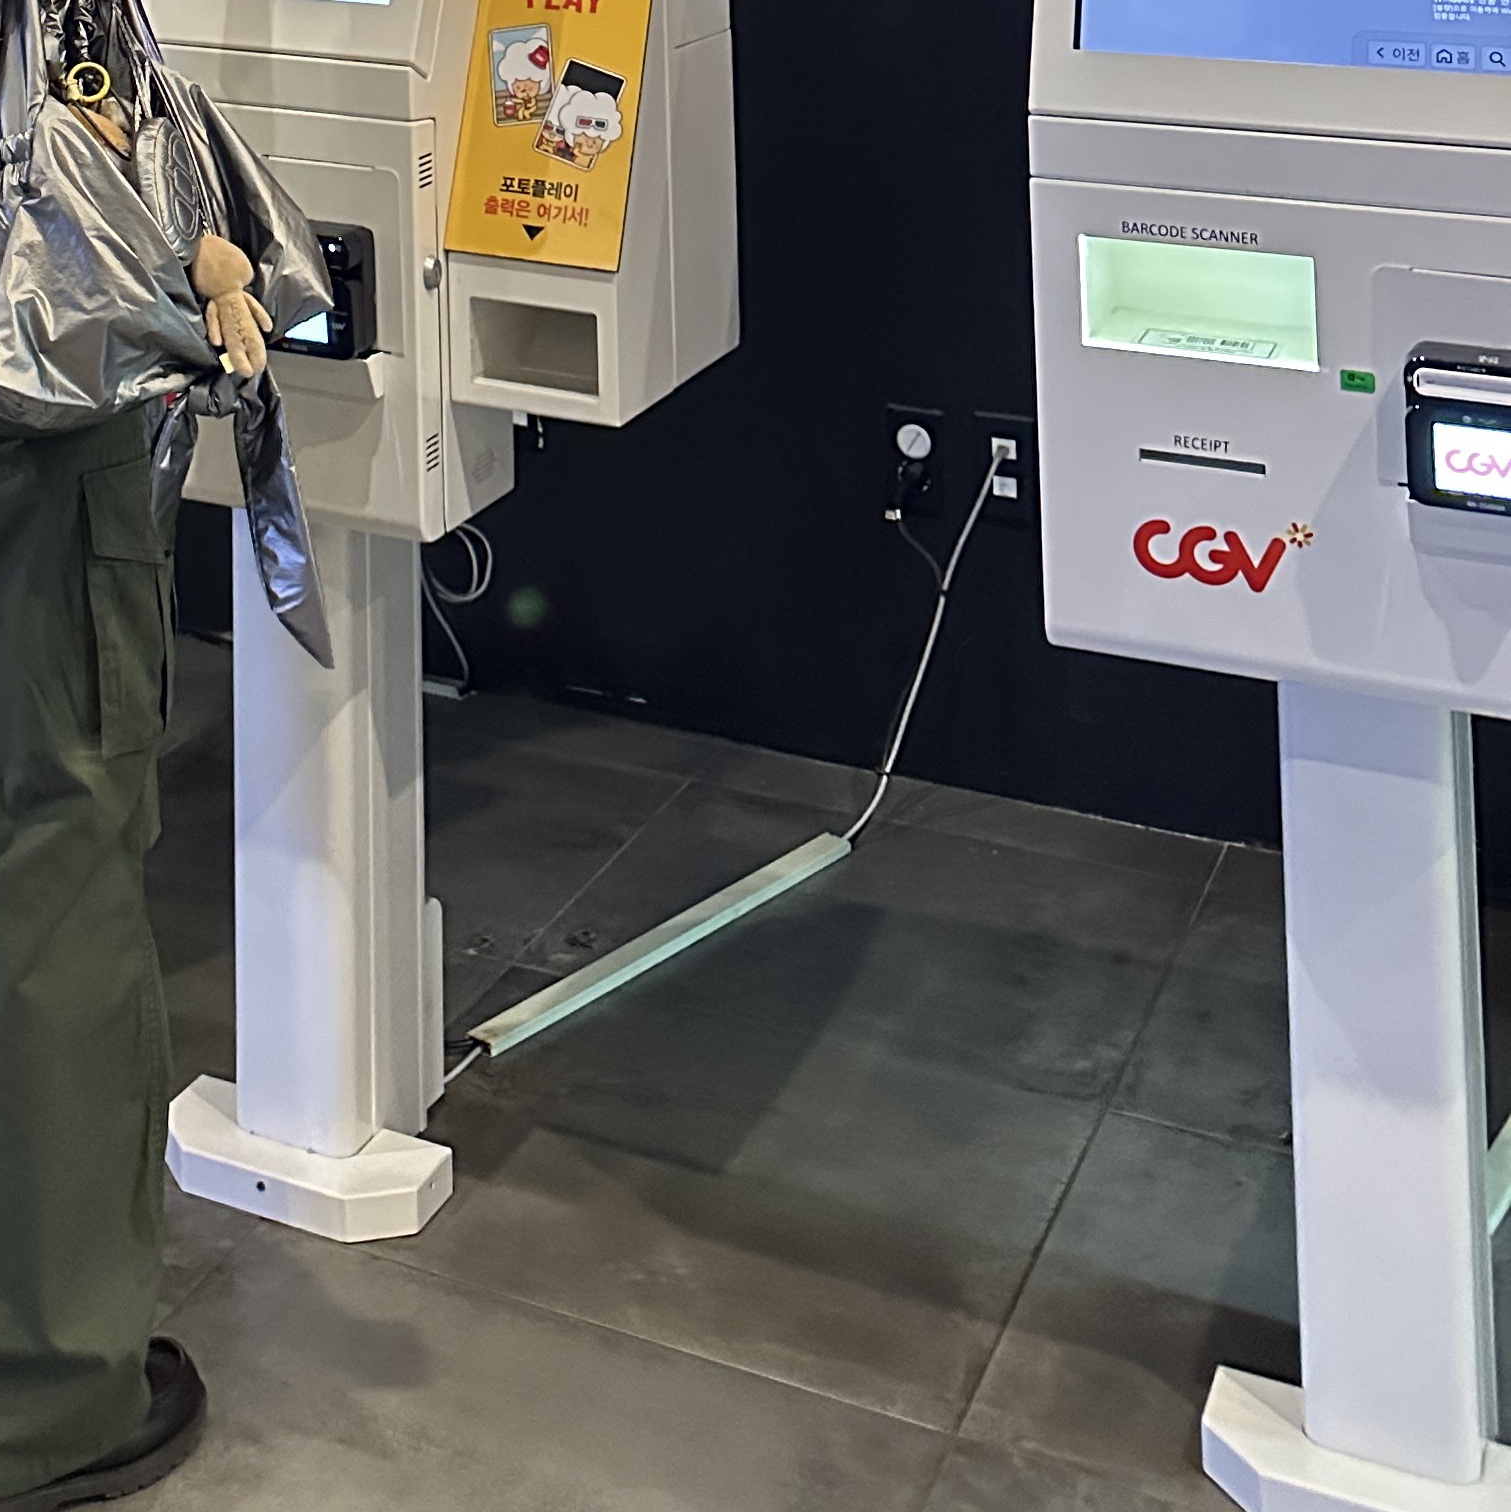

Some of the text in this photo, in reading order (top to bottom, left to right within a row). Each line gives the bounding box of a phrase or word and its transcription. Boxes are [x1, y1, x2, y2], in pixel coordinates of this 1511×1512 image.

[1391, 46, 1420, 64] 이전
[499, 175, 579, 201] 포토플레이
[483, 196, 590, 227] 출력은 여기서!
[1121, 220, 1259, 246] BARCODE SCANNER
[1173, 434, 1230, 455] RECEIPT
[1445, 449, 1511, 479] CGV
[1133, 519, 1287, 593] CGV
